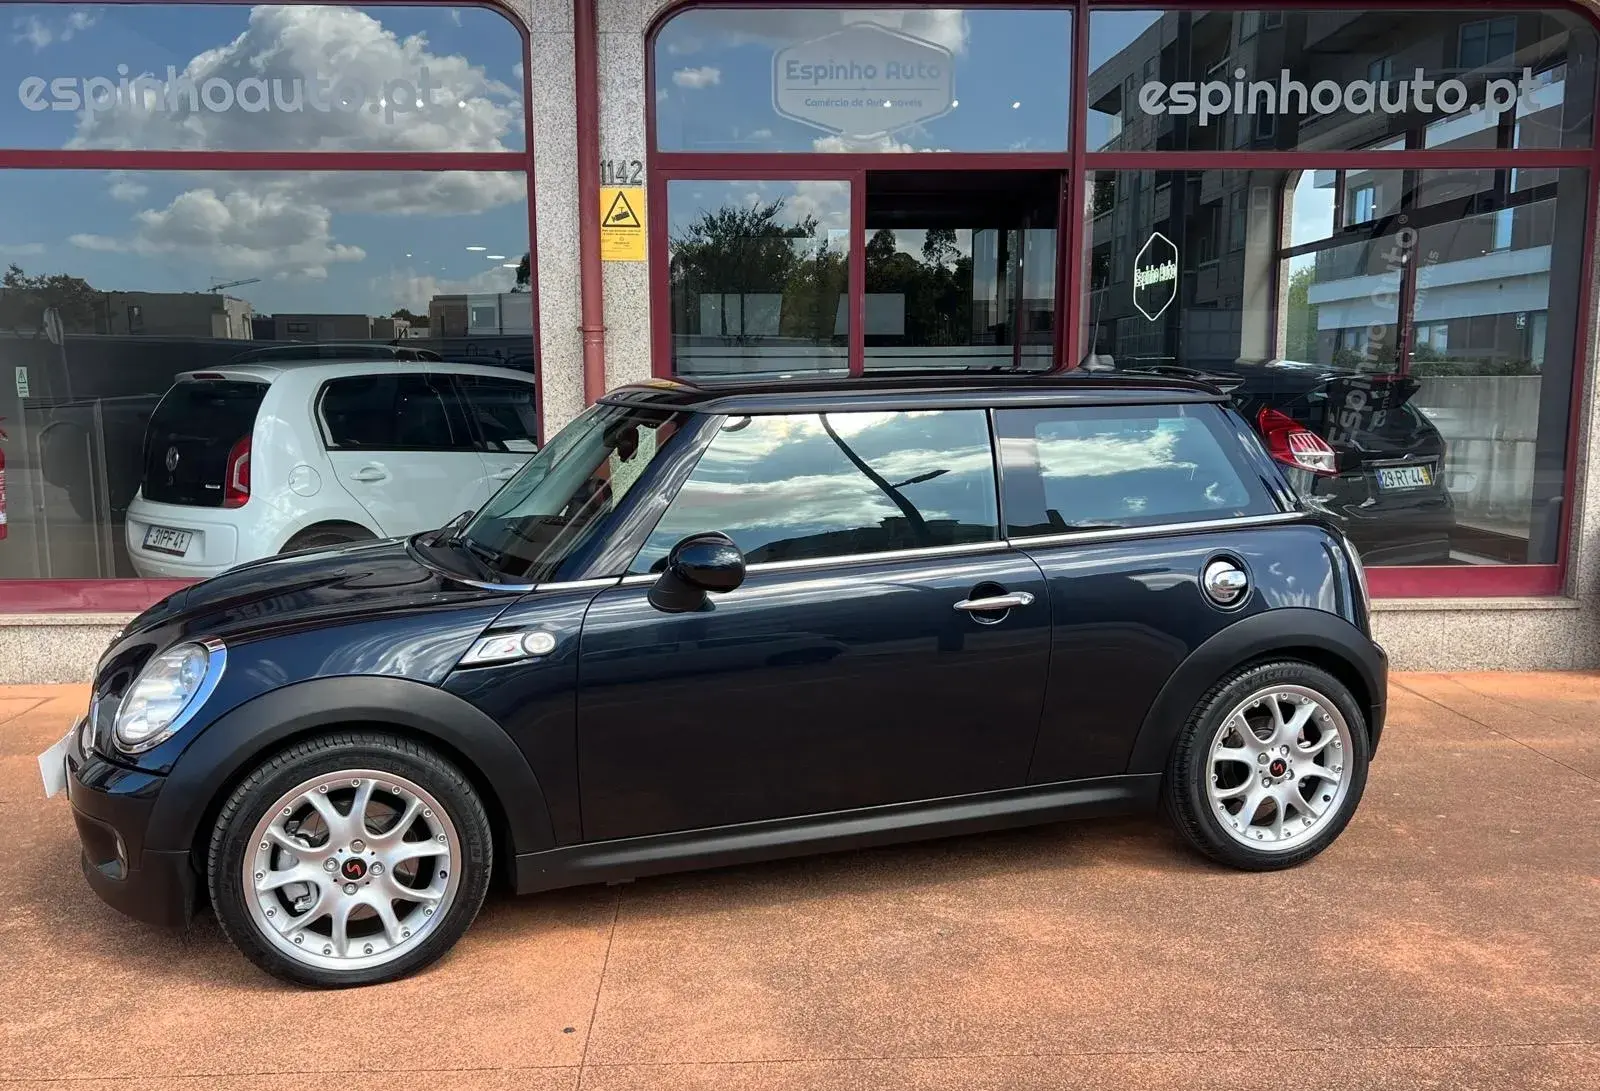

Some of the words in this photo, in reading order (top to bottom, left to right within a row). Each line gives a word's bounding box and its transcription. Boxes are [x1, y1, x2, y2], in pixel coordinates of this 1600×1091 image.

[785, 59, 877, 86] Espinho
[885, 60, 942, 80] Auto
[18, 63, 443, 125] espinhoauto.pt
[851, 97, 864, 107] de
[1138, 67, 1543, 126] espinhoauto.pt
[600, 160, 642, 185] 1142
